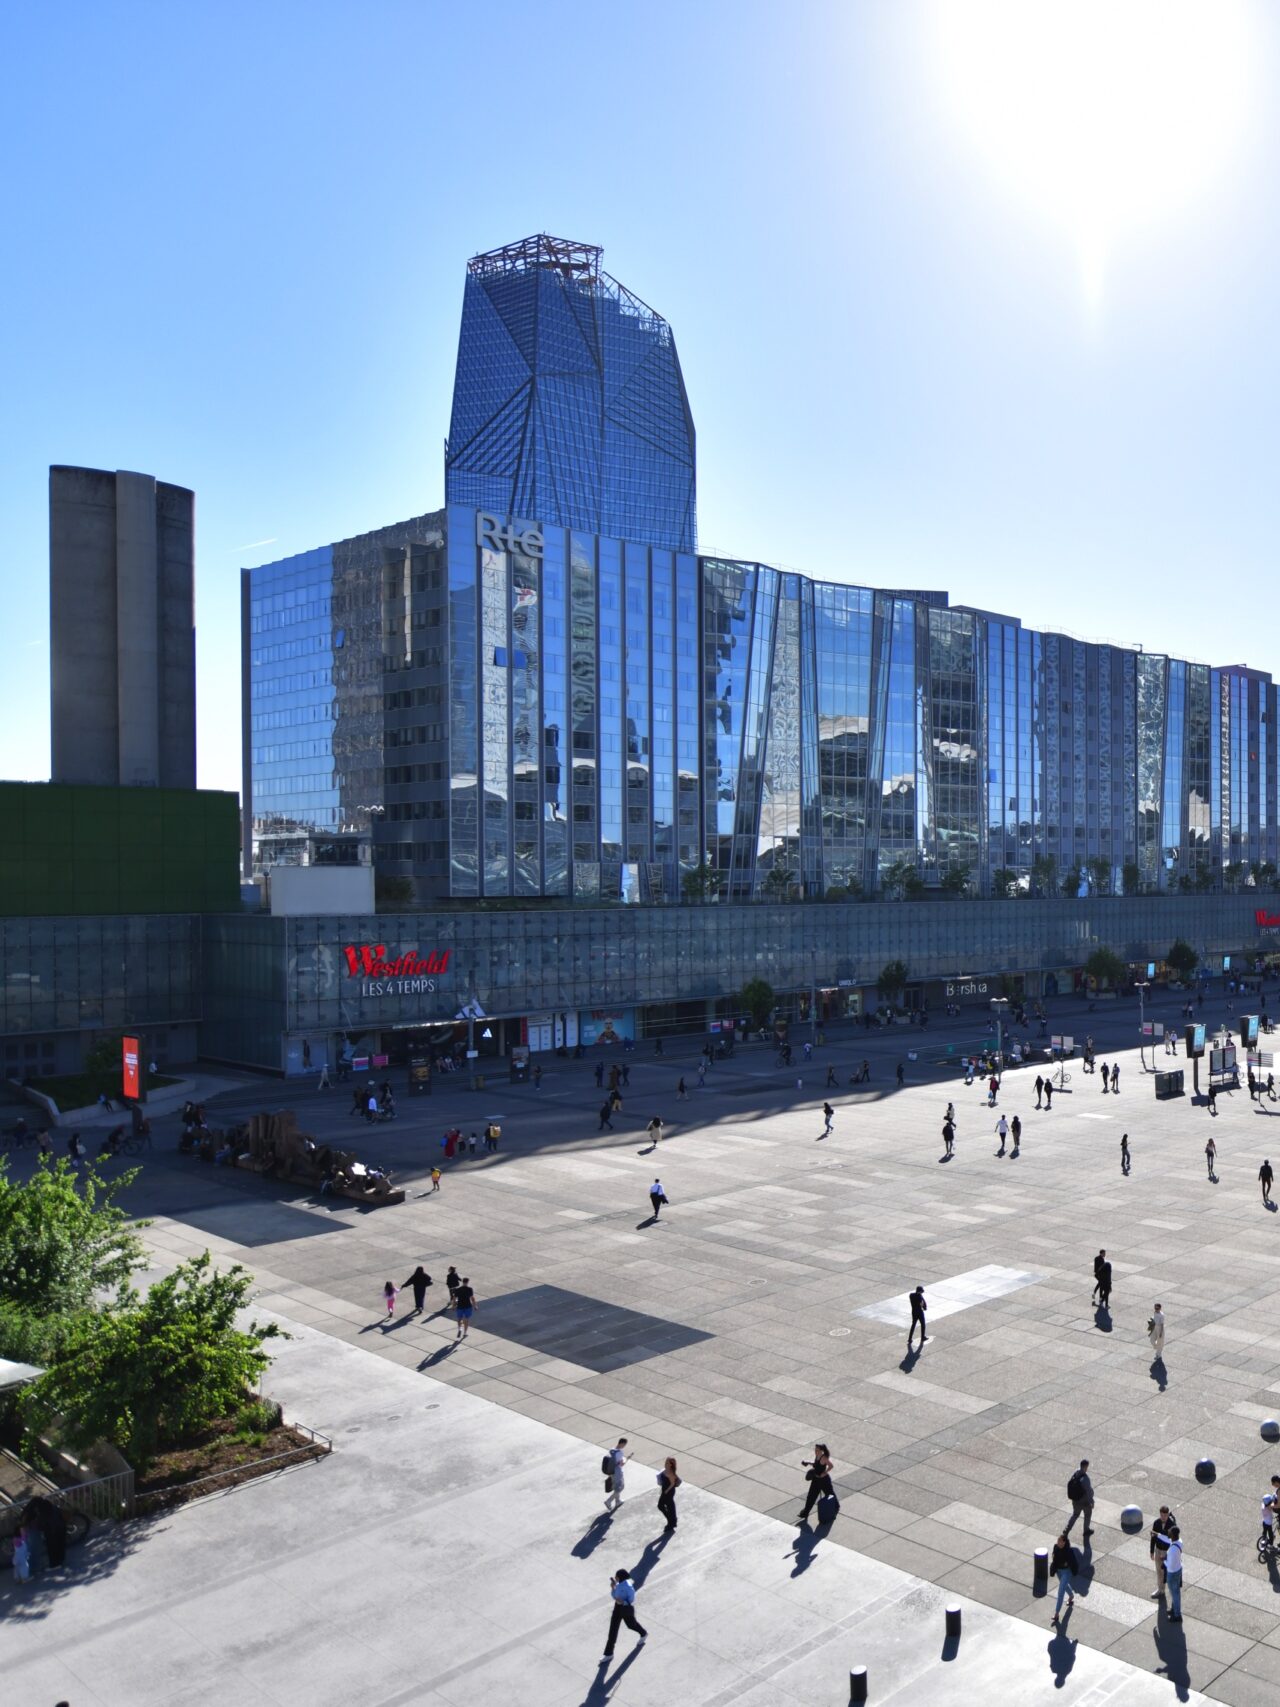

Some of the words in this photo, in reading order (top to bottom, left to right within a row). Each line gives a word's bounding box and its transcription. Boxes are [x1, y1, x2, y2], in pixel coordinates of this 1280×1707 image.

[344, 944, 452, 977] Westfield
[362, 982, 383, 997] LES
[386, 982, 394, 995] 4
[397, 979, 435, 994] TEMPS
